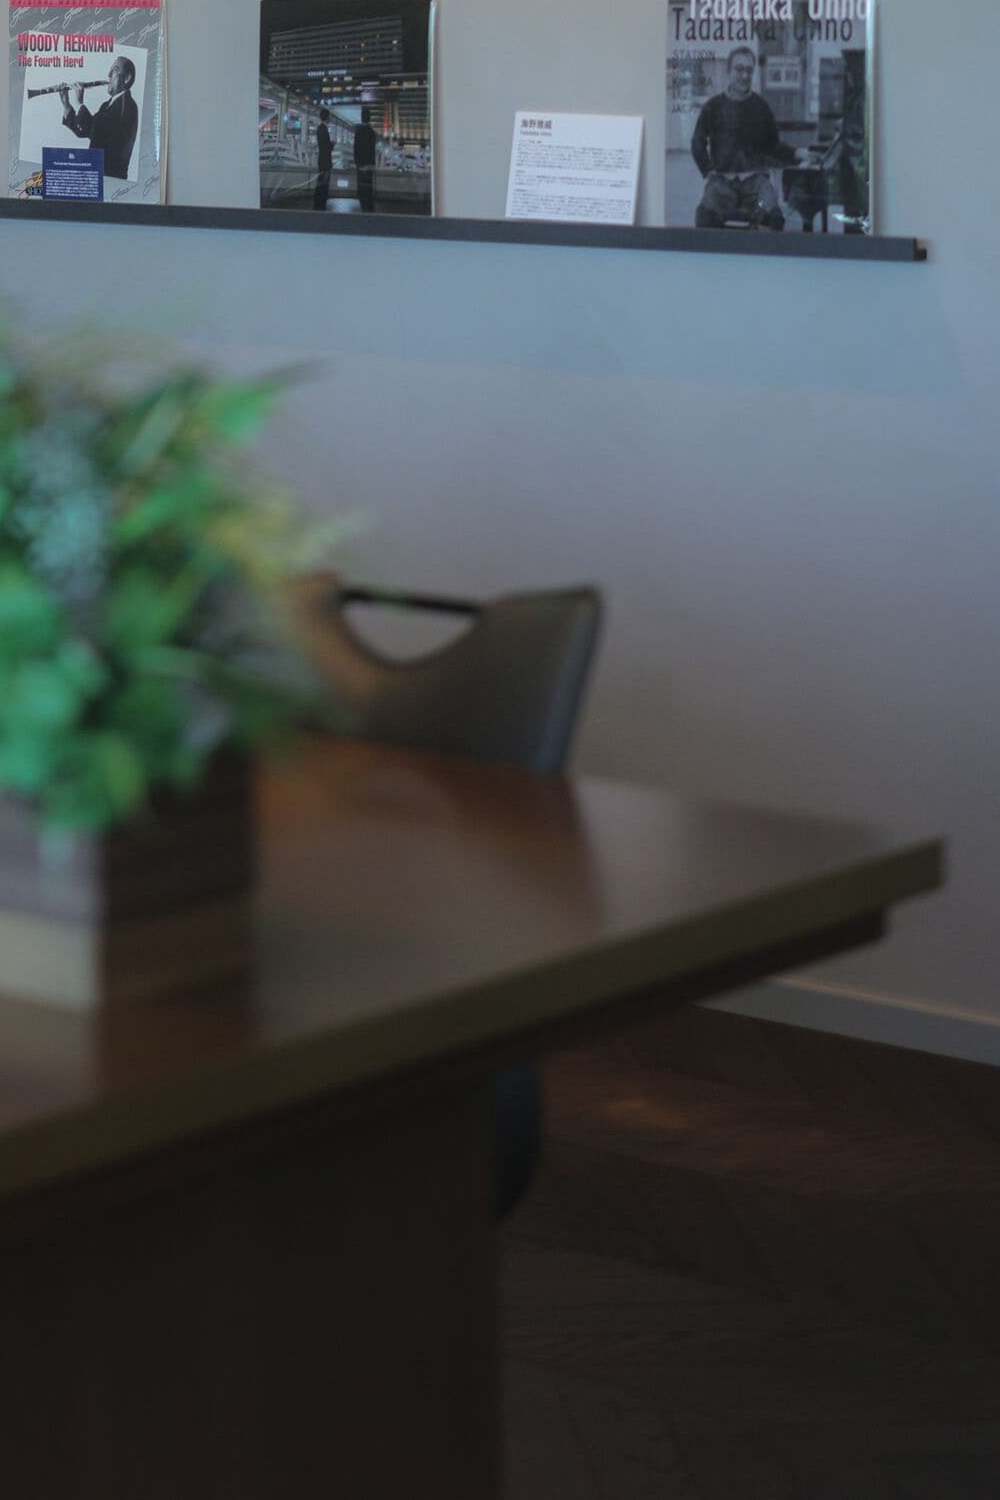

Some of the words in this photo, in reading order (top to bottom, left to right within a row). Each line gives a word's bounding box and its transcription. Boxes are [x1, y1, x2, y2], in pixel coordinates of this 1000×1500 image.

[672, 7, 776, 42] Tadataka
[18, 33, 60, 52] WOODY
[63, 34, 114, 53] HERMAN
[18, 54, 32, 67] The
[34, 54, 61, 67] Fourth
[63, 56, 84, 68] Herd
